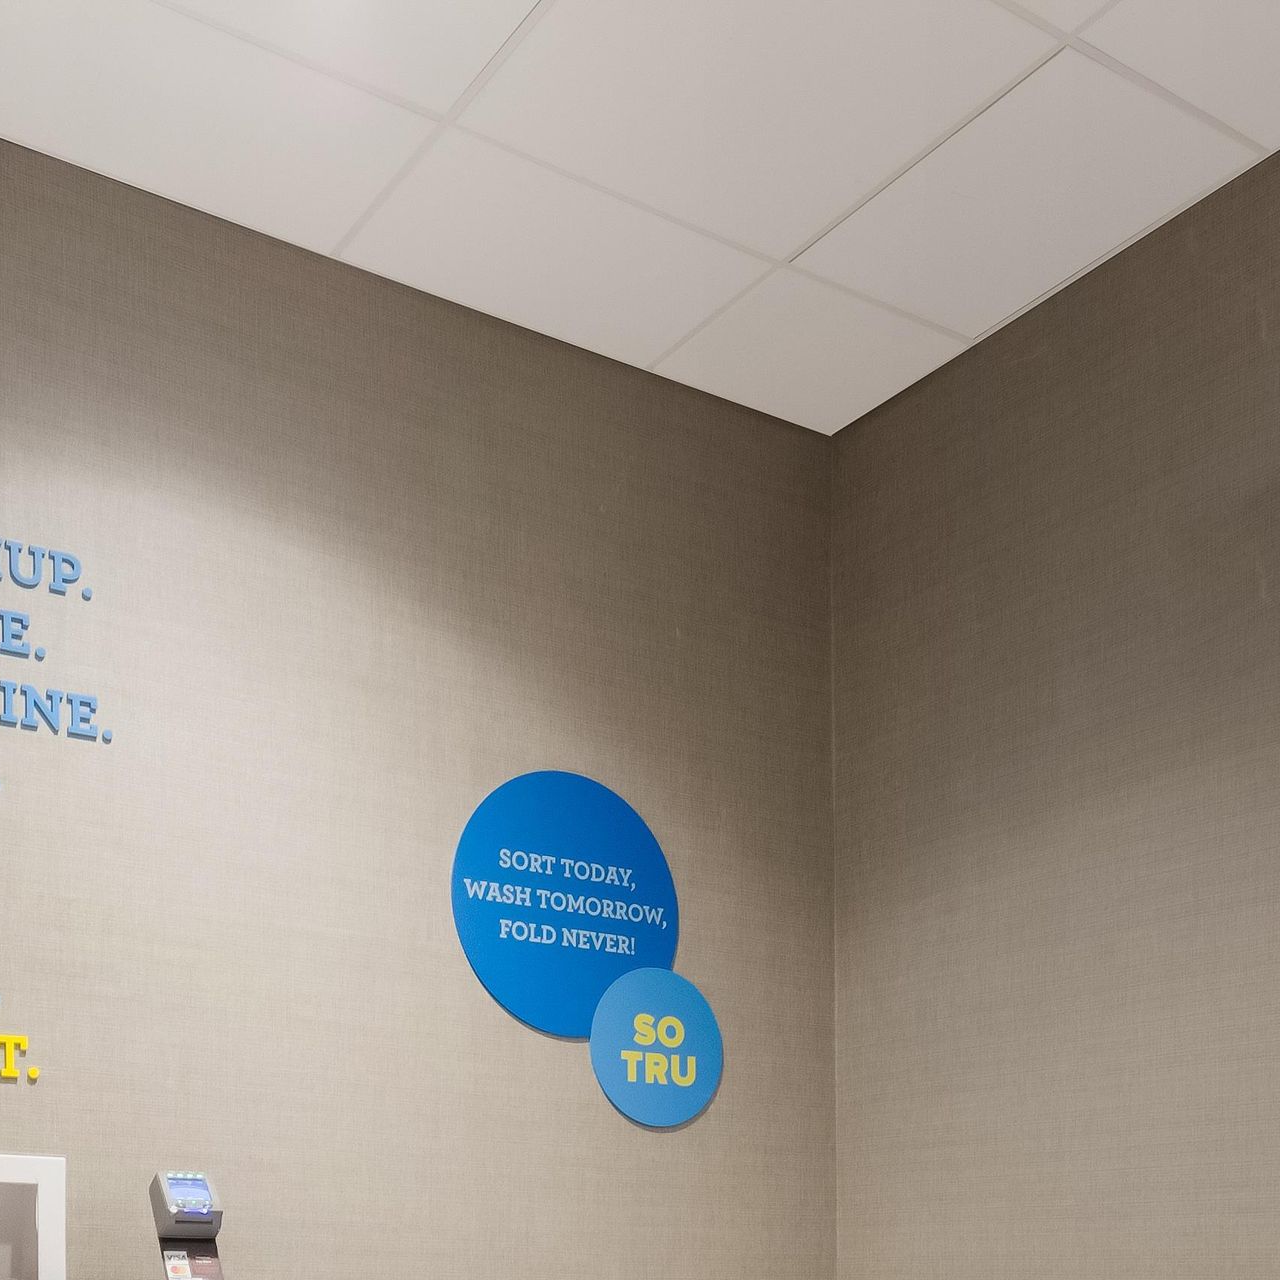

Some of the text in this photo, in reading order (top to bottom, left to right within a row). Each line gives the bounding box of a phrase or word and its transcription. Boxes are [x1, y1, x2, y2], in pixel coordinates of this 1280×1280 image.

[499, 848, 637, 892] SORT TODAY,
[463, 877, 668, 930] WASH TOMORROW,
[499, 919, 636, 956] FOLD NEVER!
[633, 1013, 685, 1048] SO
[620, 1050, 697, 1087] TRU
